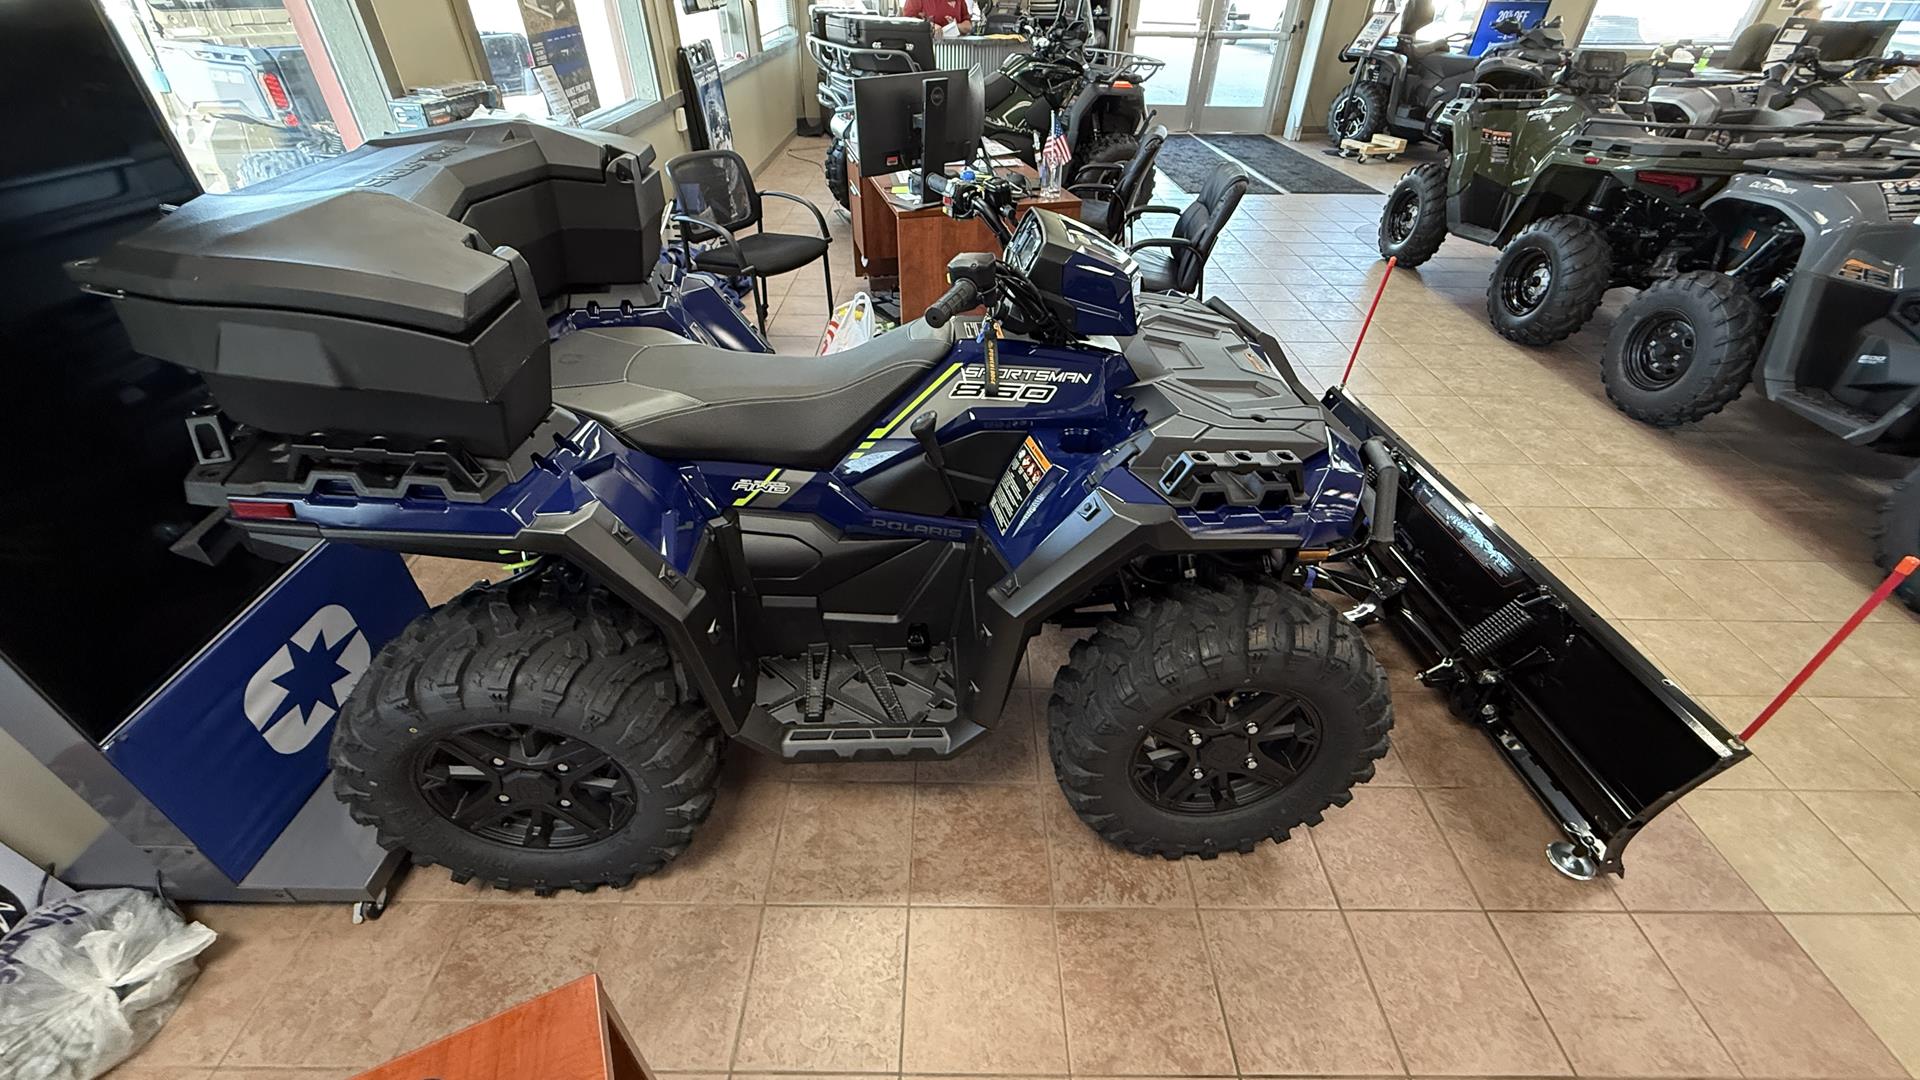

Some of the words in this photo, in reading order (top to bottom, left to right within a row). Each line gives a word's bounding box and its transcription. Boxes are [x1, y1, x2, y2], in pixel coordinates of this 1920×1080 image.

[1513, 10, 1531, 23] OFF
[949, 380, 1058, 403] 850
[731, 481, 791, 495] AWD
[872, 518, 963, 538] POLARIS
